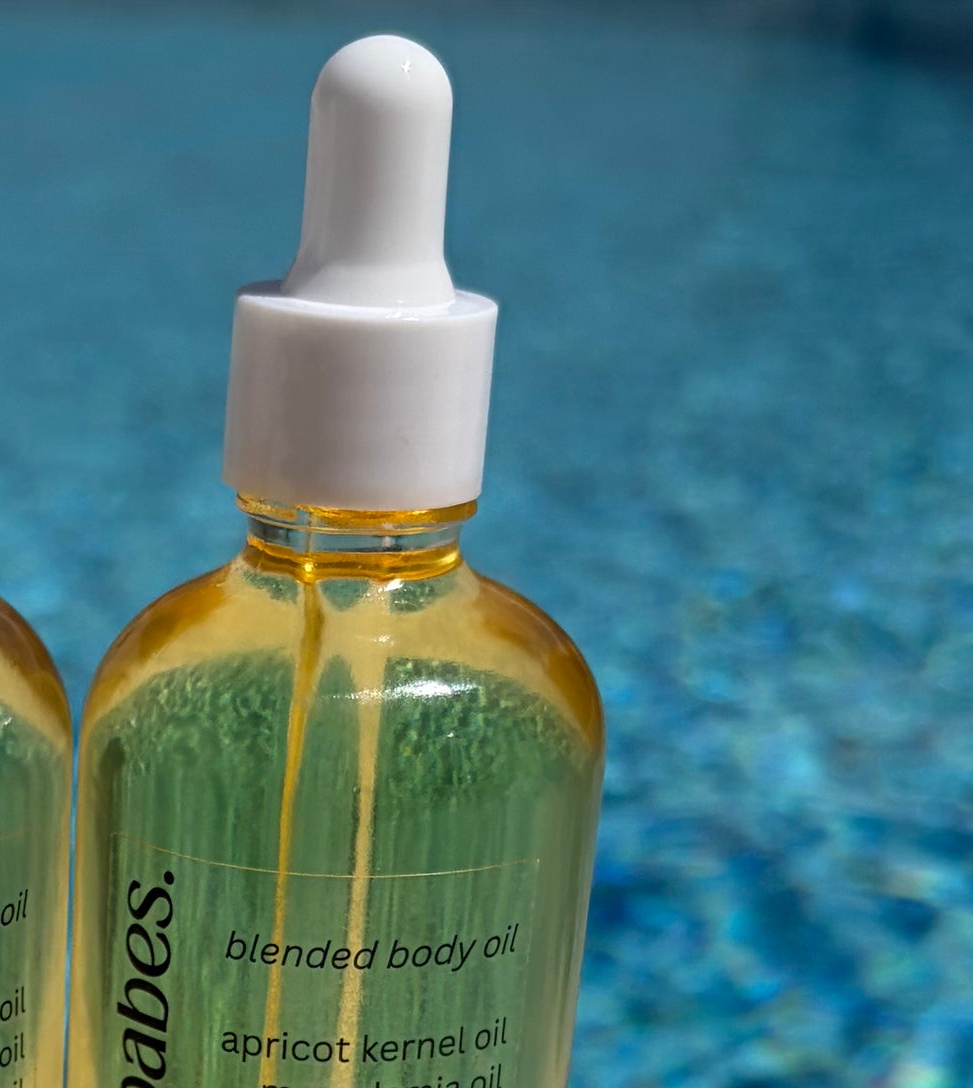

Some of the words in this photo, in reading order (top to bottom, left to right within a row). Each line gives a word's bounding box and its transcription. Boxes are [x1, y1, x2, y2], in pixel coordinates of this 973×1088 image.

[0, 890, 29, 926] oil
[225, 931, 378, 970] blended
[387, 934, 476, 972] body
[483, 923, 519, 959] oil
[0, 987, 26, 1022] oil
[0, 1034, 26, 1070] oil
[221, 1031, 350, 1064] apricot
[362, 1026, 465, 1063] kernel
[474, 1016, 508, 1050] oil
